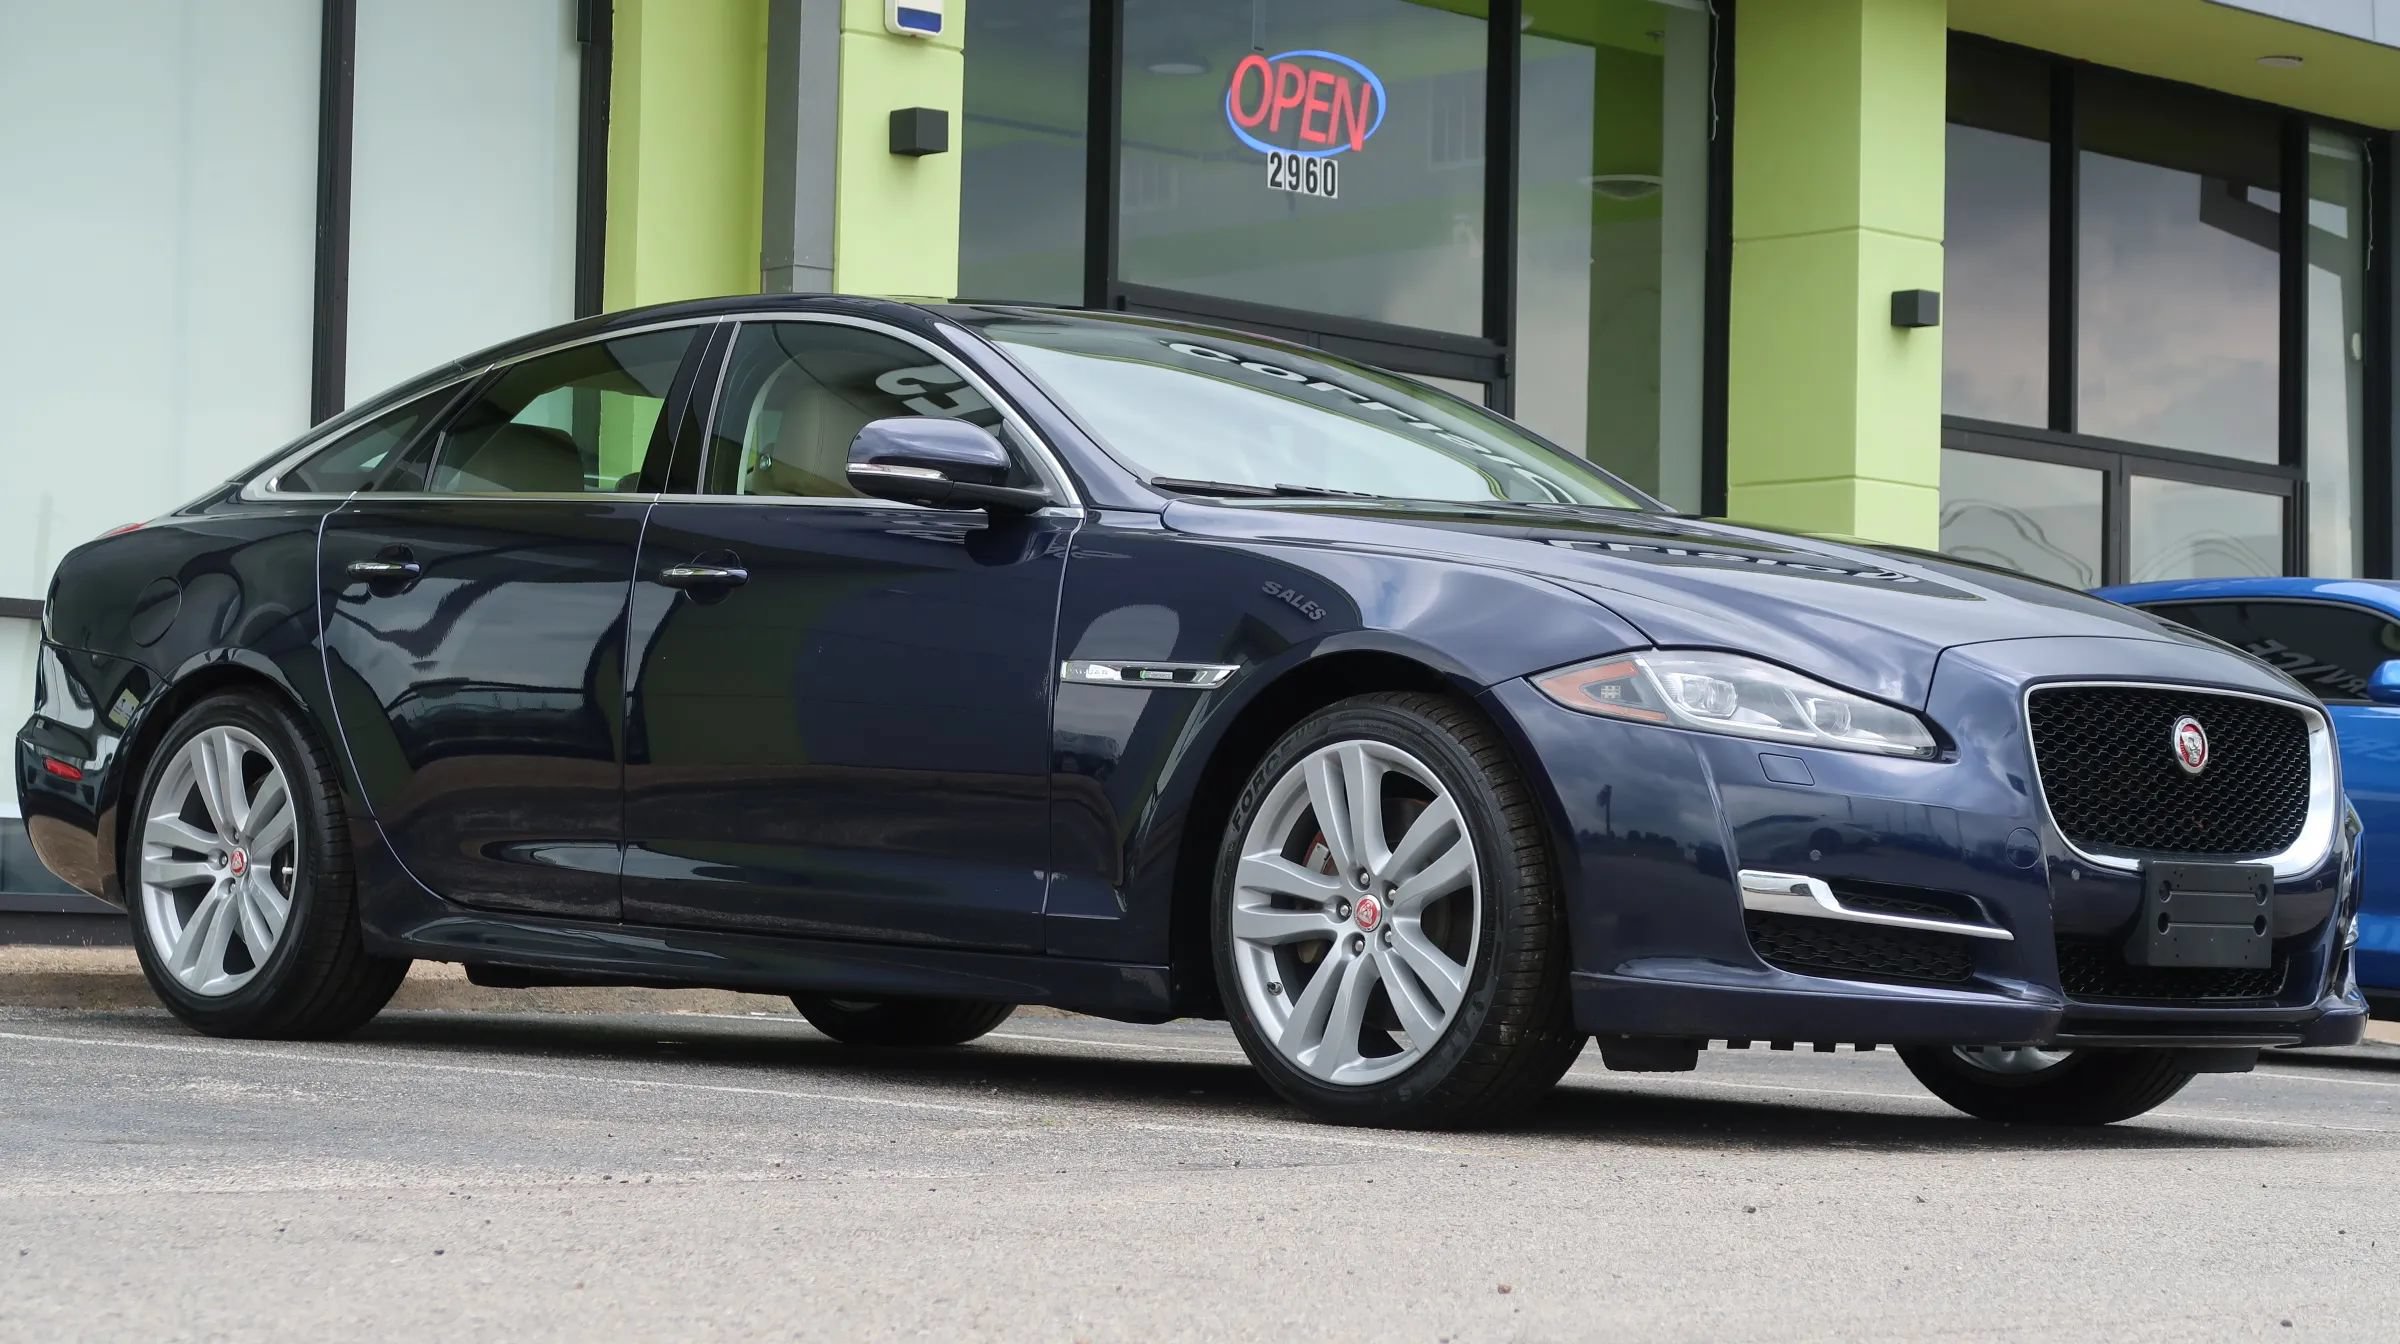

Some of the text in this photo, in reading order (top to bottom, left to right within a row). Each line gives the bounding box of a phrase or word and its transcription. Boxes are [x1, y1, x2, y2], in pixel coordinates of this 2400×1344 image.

[1231, 54, 1372, 151] OPEN
[1269, 151, 1337, 197] 2960
[1261, 580, 1327, 621] SALES
